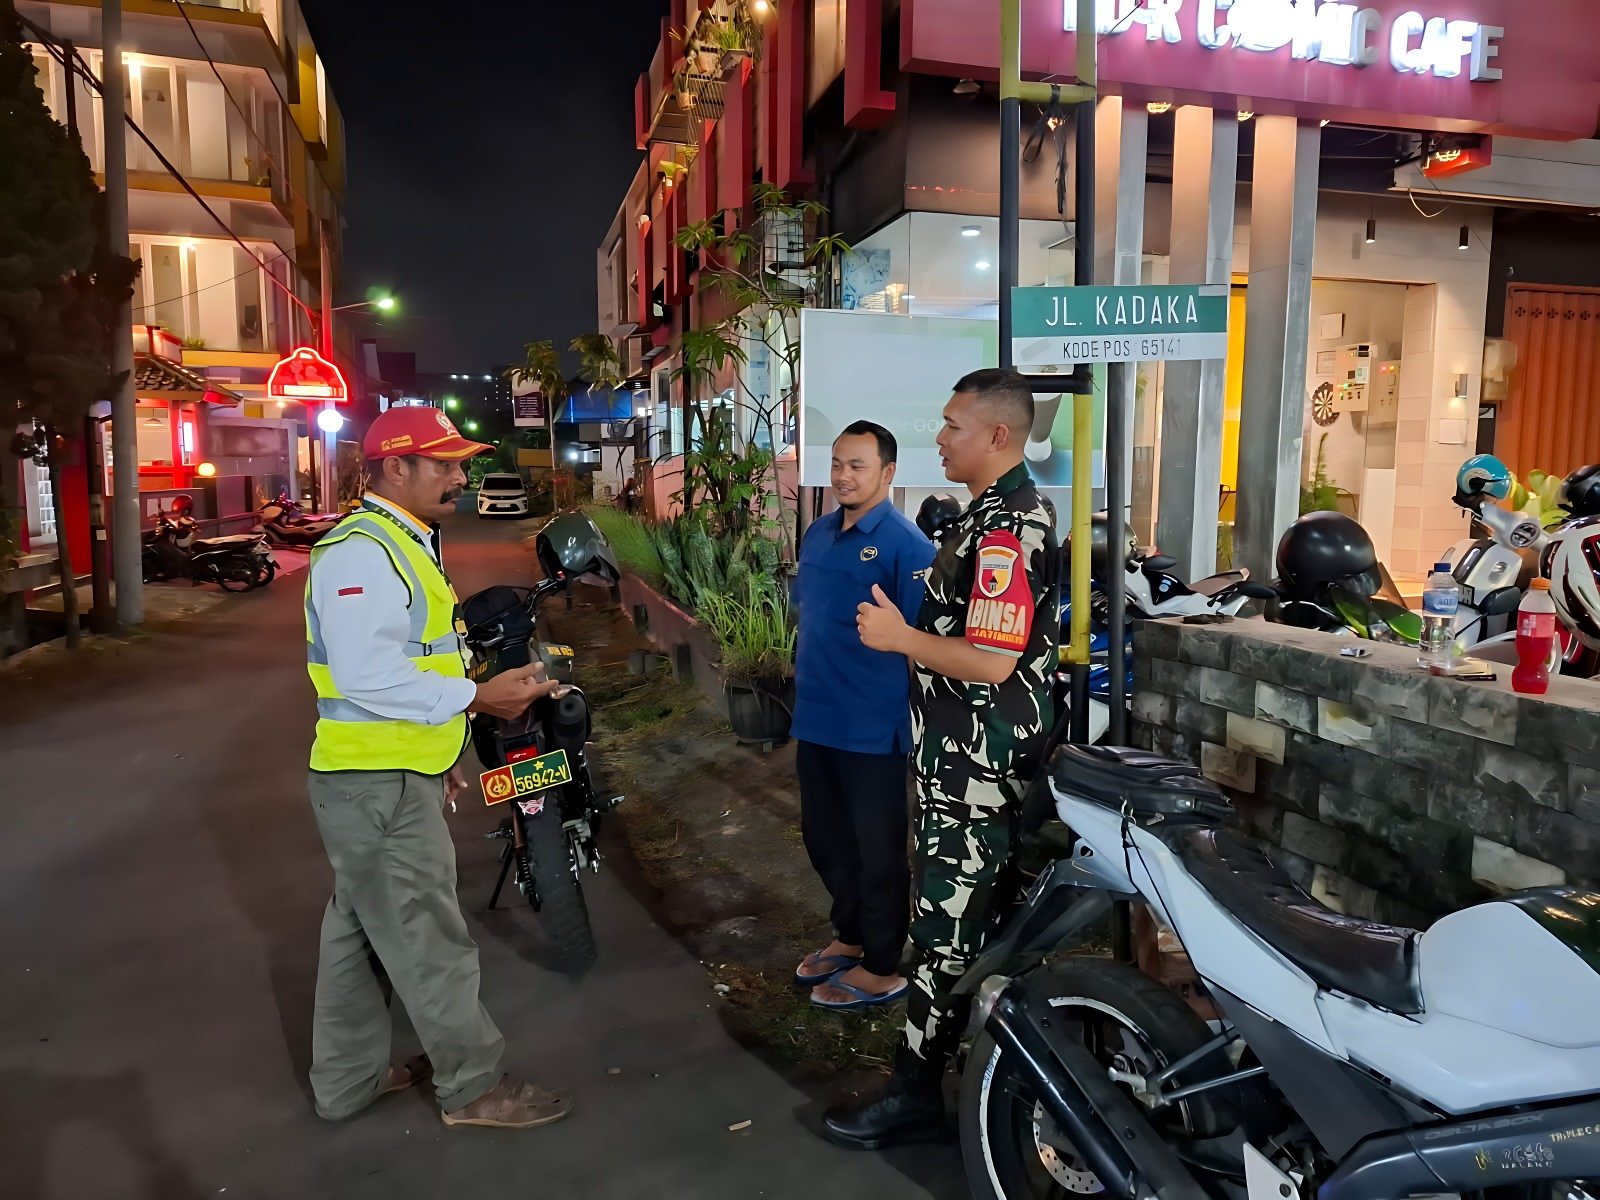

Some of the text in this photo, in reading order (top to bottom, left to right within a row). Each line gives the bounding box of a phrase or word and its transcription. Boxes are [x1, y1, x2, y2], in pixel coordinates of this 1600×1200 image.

[1390, 11, 1504, 82] CAFE
[1045, 294, 1198, 326] JL. KADAKA
[1063, 338, 1182, 359] KODE POS 65141
[515, 763, 568, 793] 56942-V
